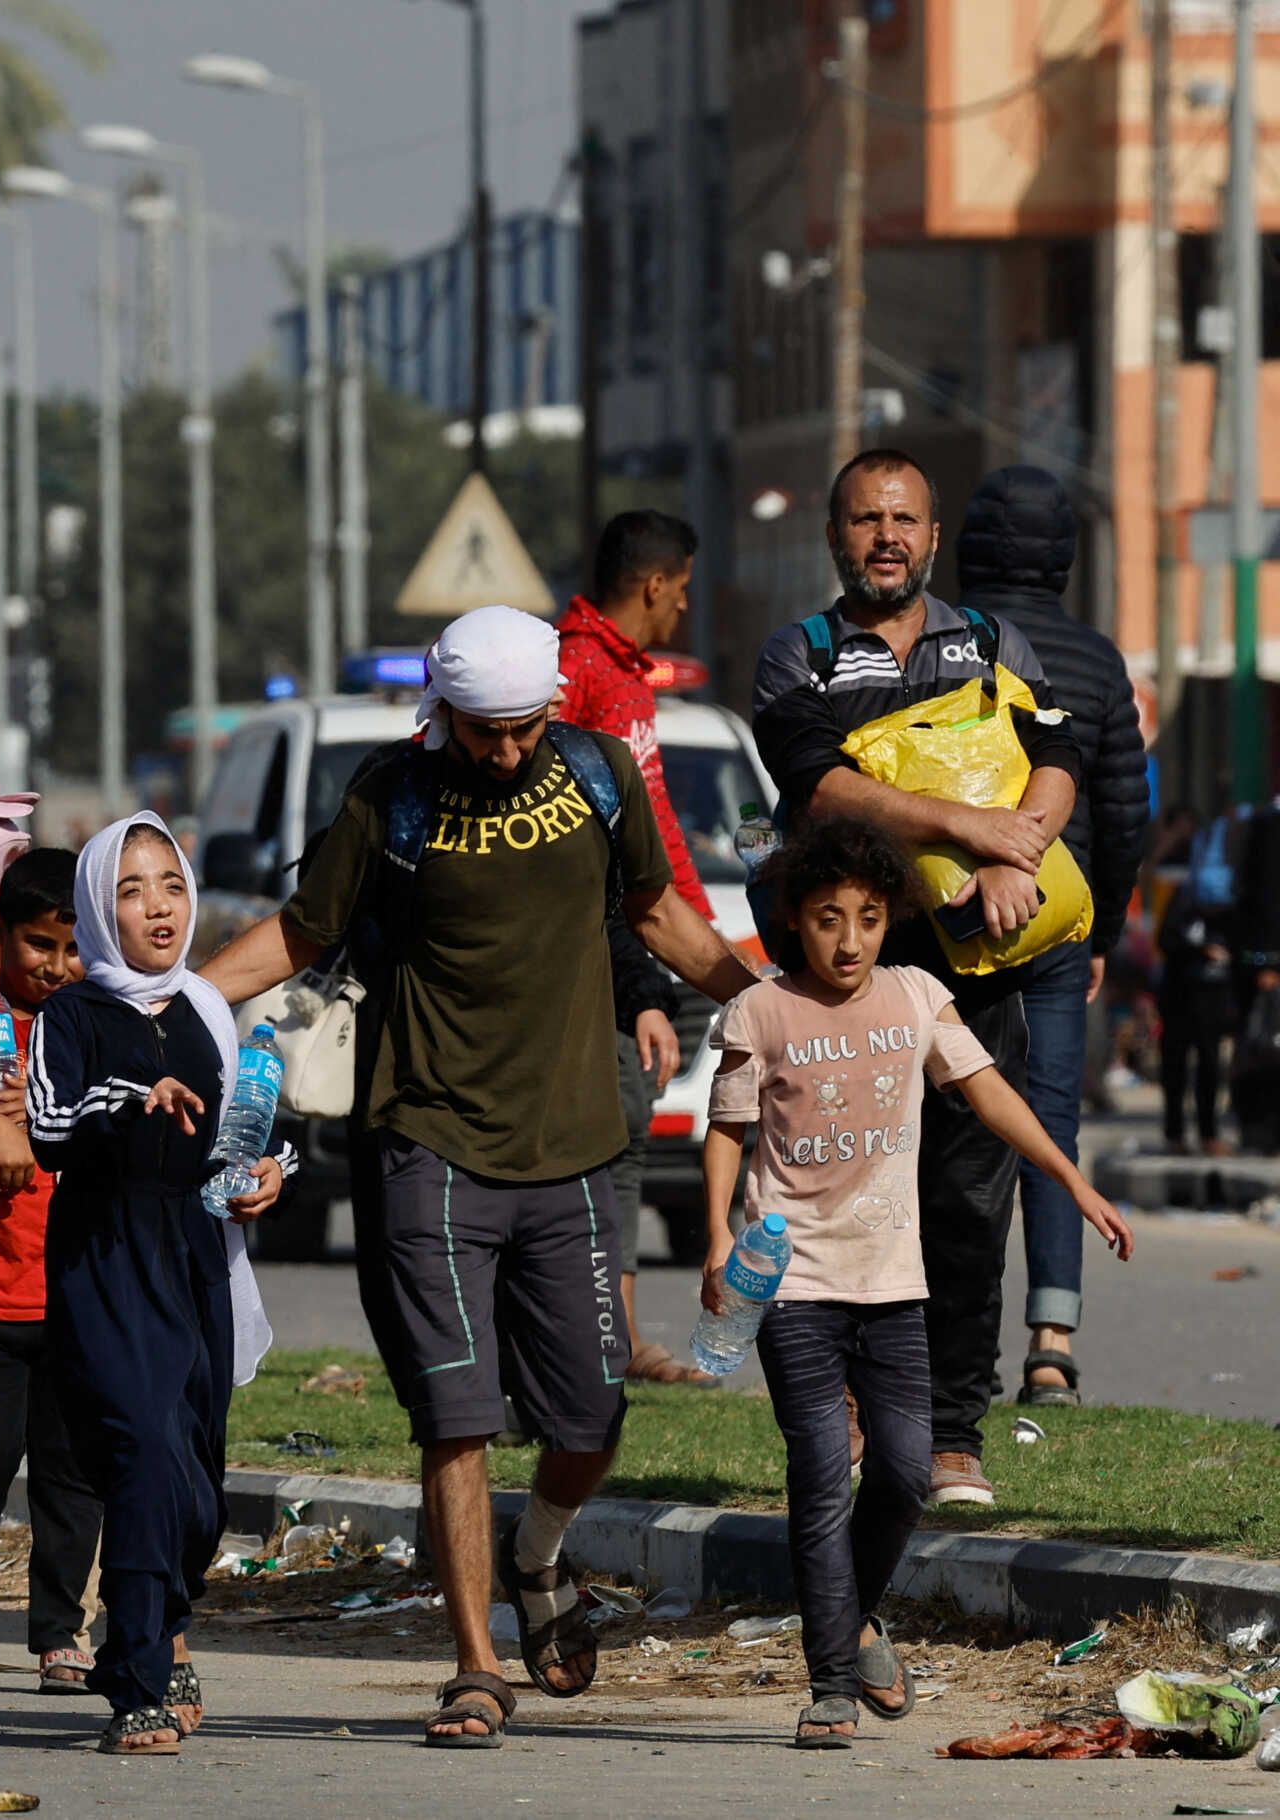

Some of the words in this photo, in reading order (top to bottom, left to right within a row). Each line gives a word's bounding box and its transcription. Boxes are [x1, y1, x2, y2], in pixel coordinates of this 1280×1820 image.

[943, 638, 988, 665] ad
[425, 778, 593, 854] LIFORN
[486, 792, 535, 813] YOUR
[785, 1034, 858, 1067] WILL
[265, 1058, 285, 1077] AQ
